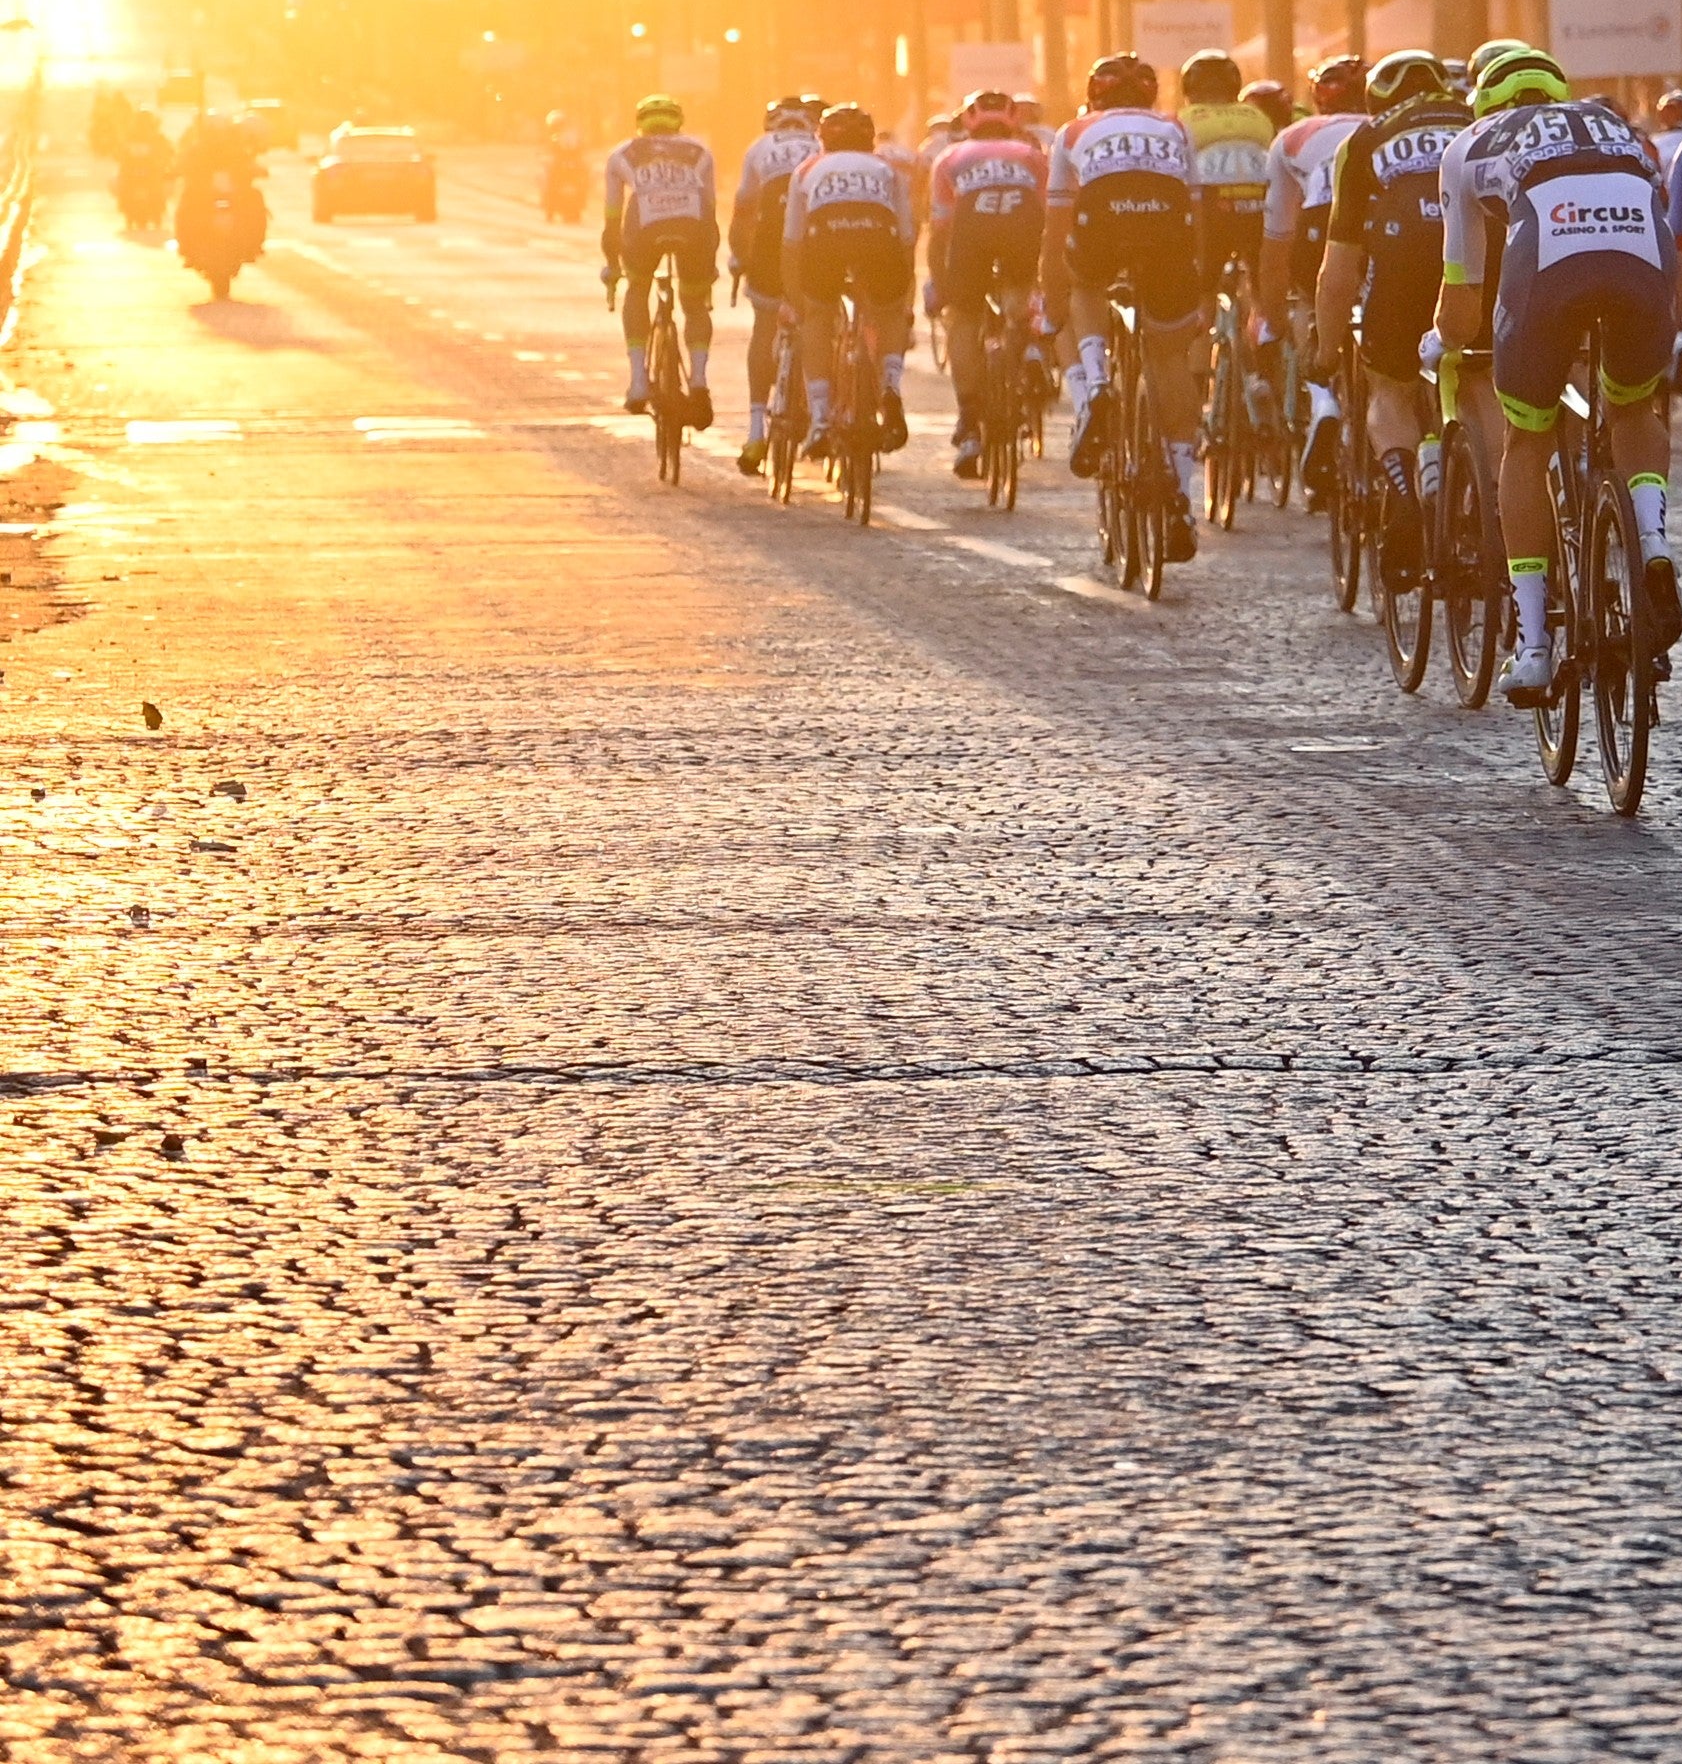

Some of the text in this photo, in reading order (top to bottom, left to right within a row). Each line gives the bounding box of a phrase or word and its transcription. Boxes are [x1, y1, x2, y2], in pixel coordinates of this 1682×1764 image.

[976, 189, 1022, 214] EF
[1551, 201, 1645, 224] Circus
[1551, 227, 1597, 237] CASINO
[1612, 224, 1646, 235] SPORT
